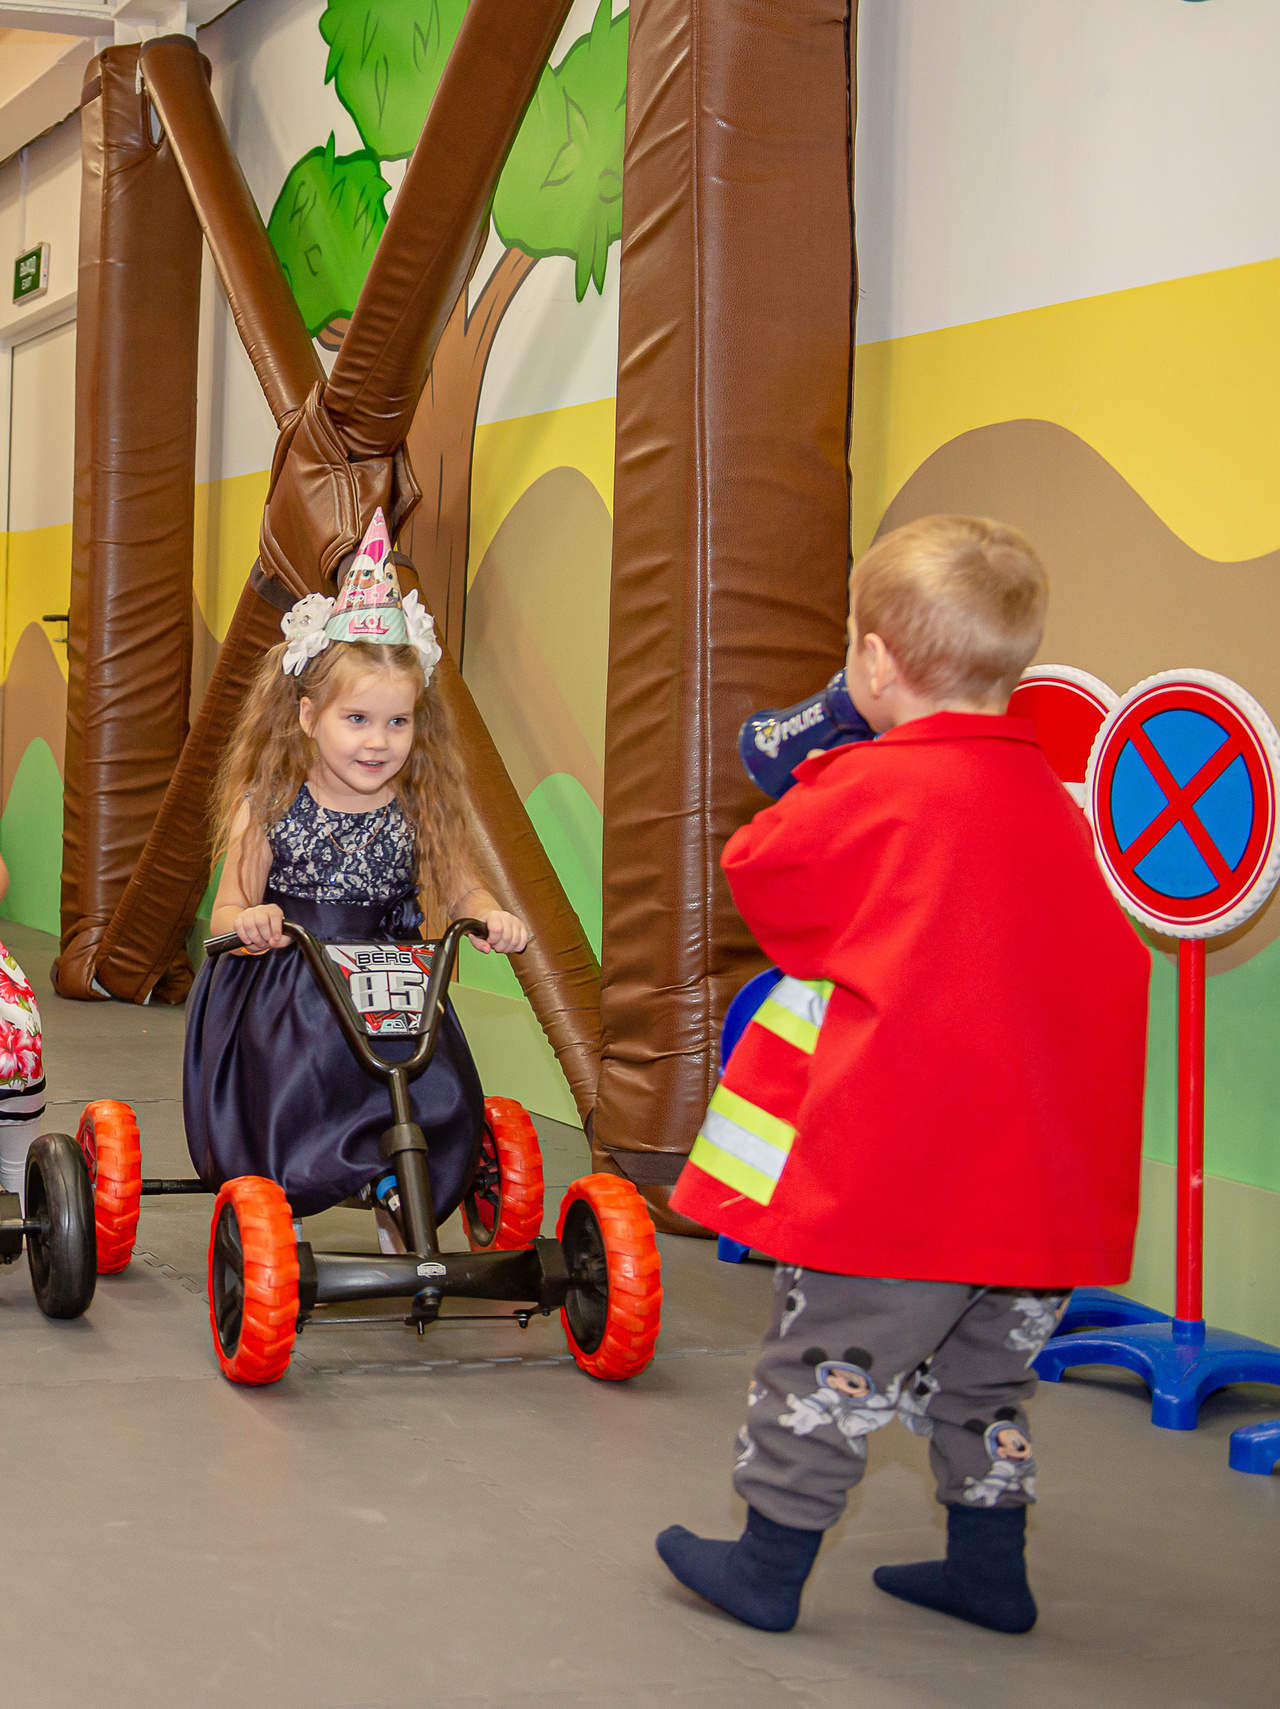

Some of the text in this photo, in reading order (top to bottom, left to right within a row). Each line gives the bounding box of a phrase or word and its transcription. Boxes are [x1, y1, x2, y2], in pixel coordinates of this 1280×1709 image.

[780, 702, 825, 741] POLICE
[357, 952, 412, 965] BERG
[349, 971, 425, 1013] 85
